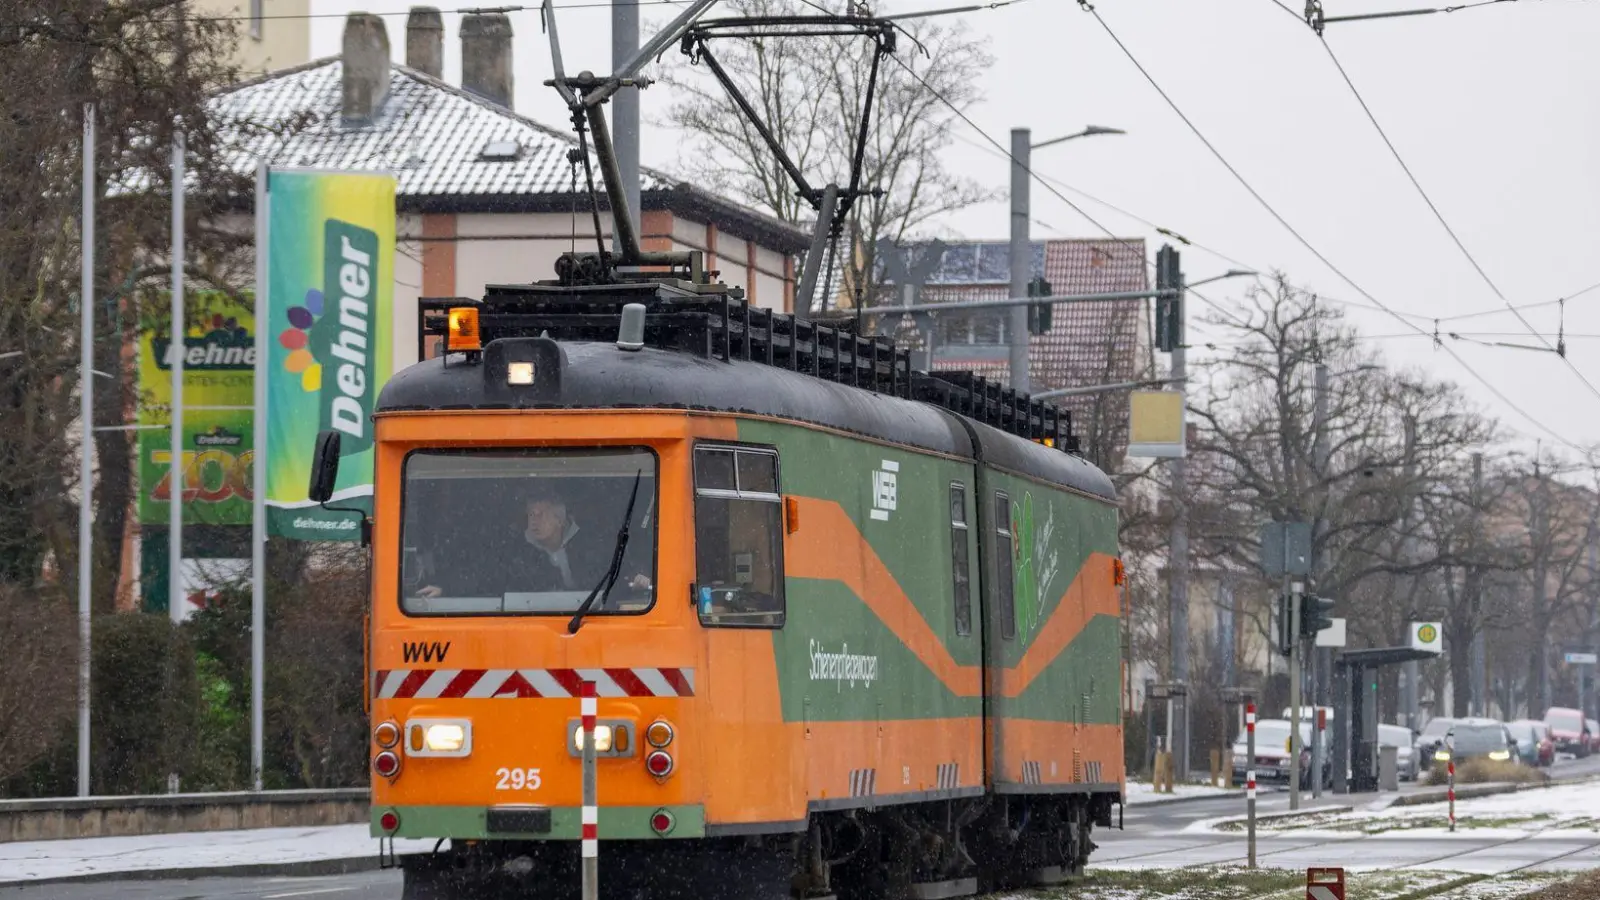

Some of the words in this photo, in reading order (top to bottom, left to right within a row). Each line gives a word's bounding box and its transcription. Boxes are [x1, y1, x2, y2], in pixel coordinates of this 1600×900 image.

[331, 236, 370, 438] Dehner
[163, 342, 255, 365] Dehne
[293, 517, 357, 530] dehner.de
[403, 641, 450, 663] WVV
[495, 767, 541, 790] 295
